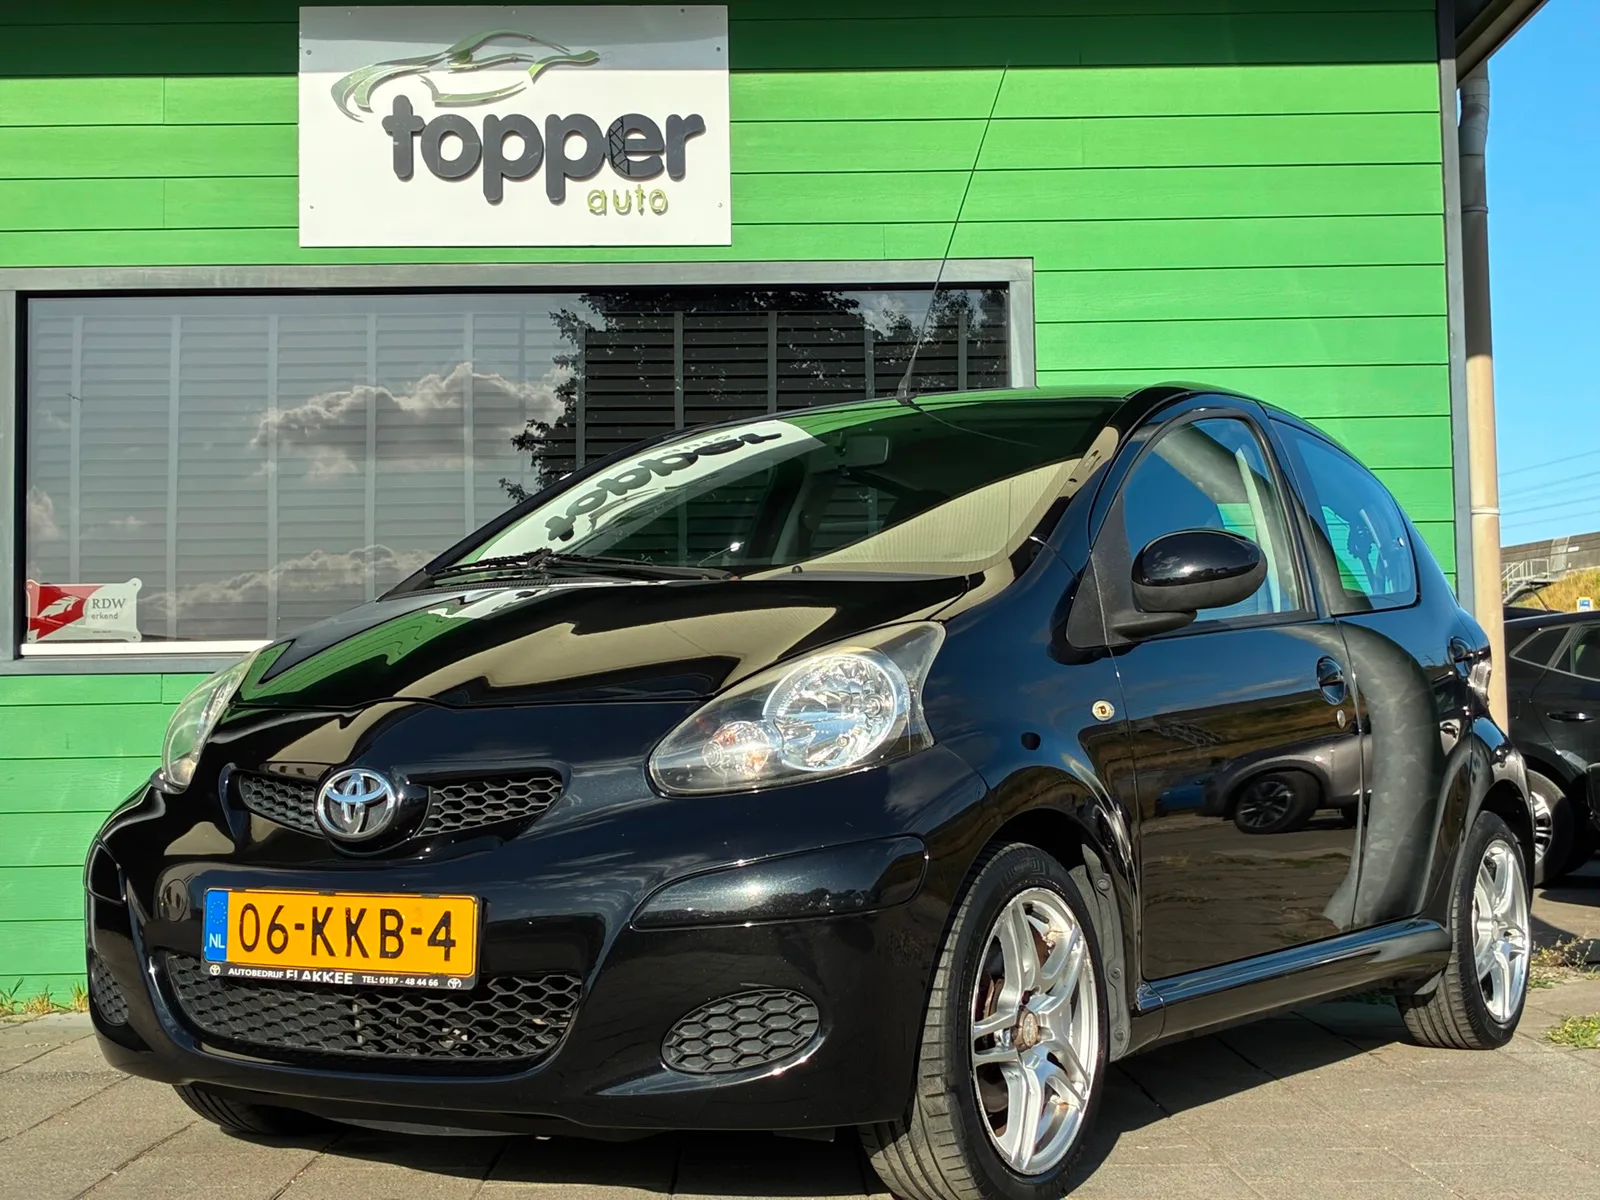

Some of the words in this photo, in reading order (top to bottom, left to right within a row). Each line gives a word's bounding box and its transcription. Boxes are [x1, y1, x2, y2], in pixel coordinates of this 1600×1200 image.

[382, 94, 706, 205] topper
[588, 185, 668, 215] auto
[92, 598, 126, 609] RDW
[91, 612, 118, 620] erkend
[208, 934, 226, 949] NL
[238, 903, 457, 962] 06-KKB-4
[228, 968, 284, 979] AUTOBEDRIJF
[362, 975, 378, 984] TEL:
[379, 976, 399, 985] 0187
[405, 978, 415, 986] 48
[417, 978, 427, 986] 44
[428, 978, 439, 987] 66
